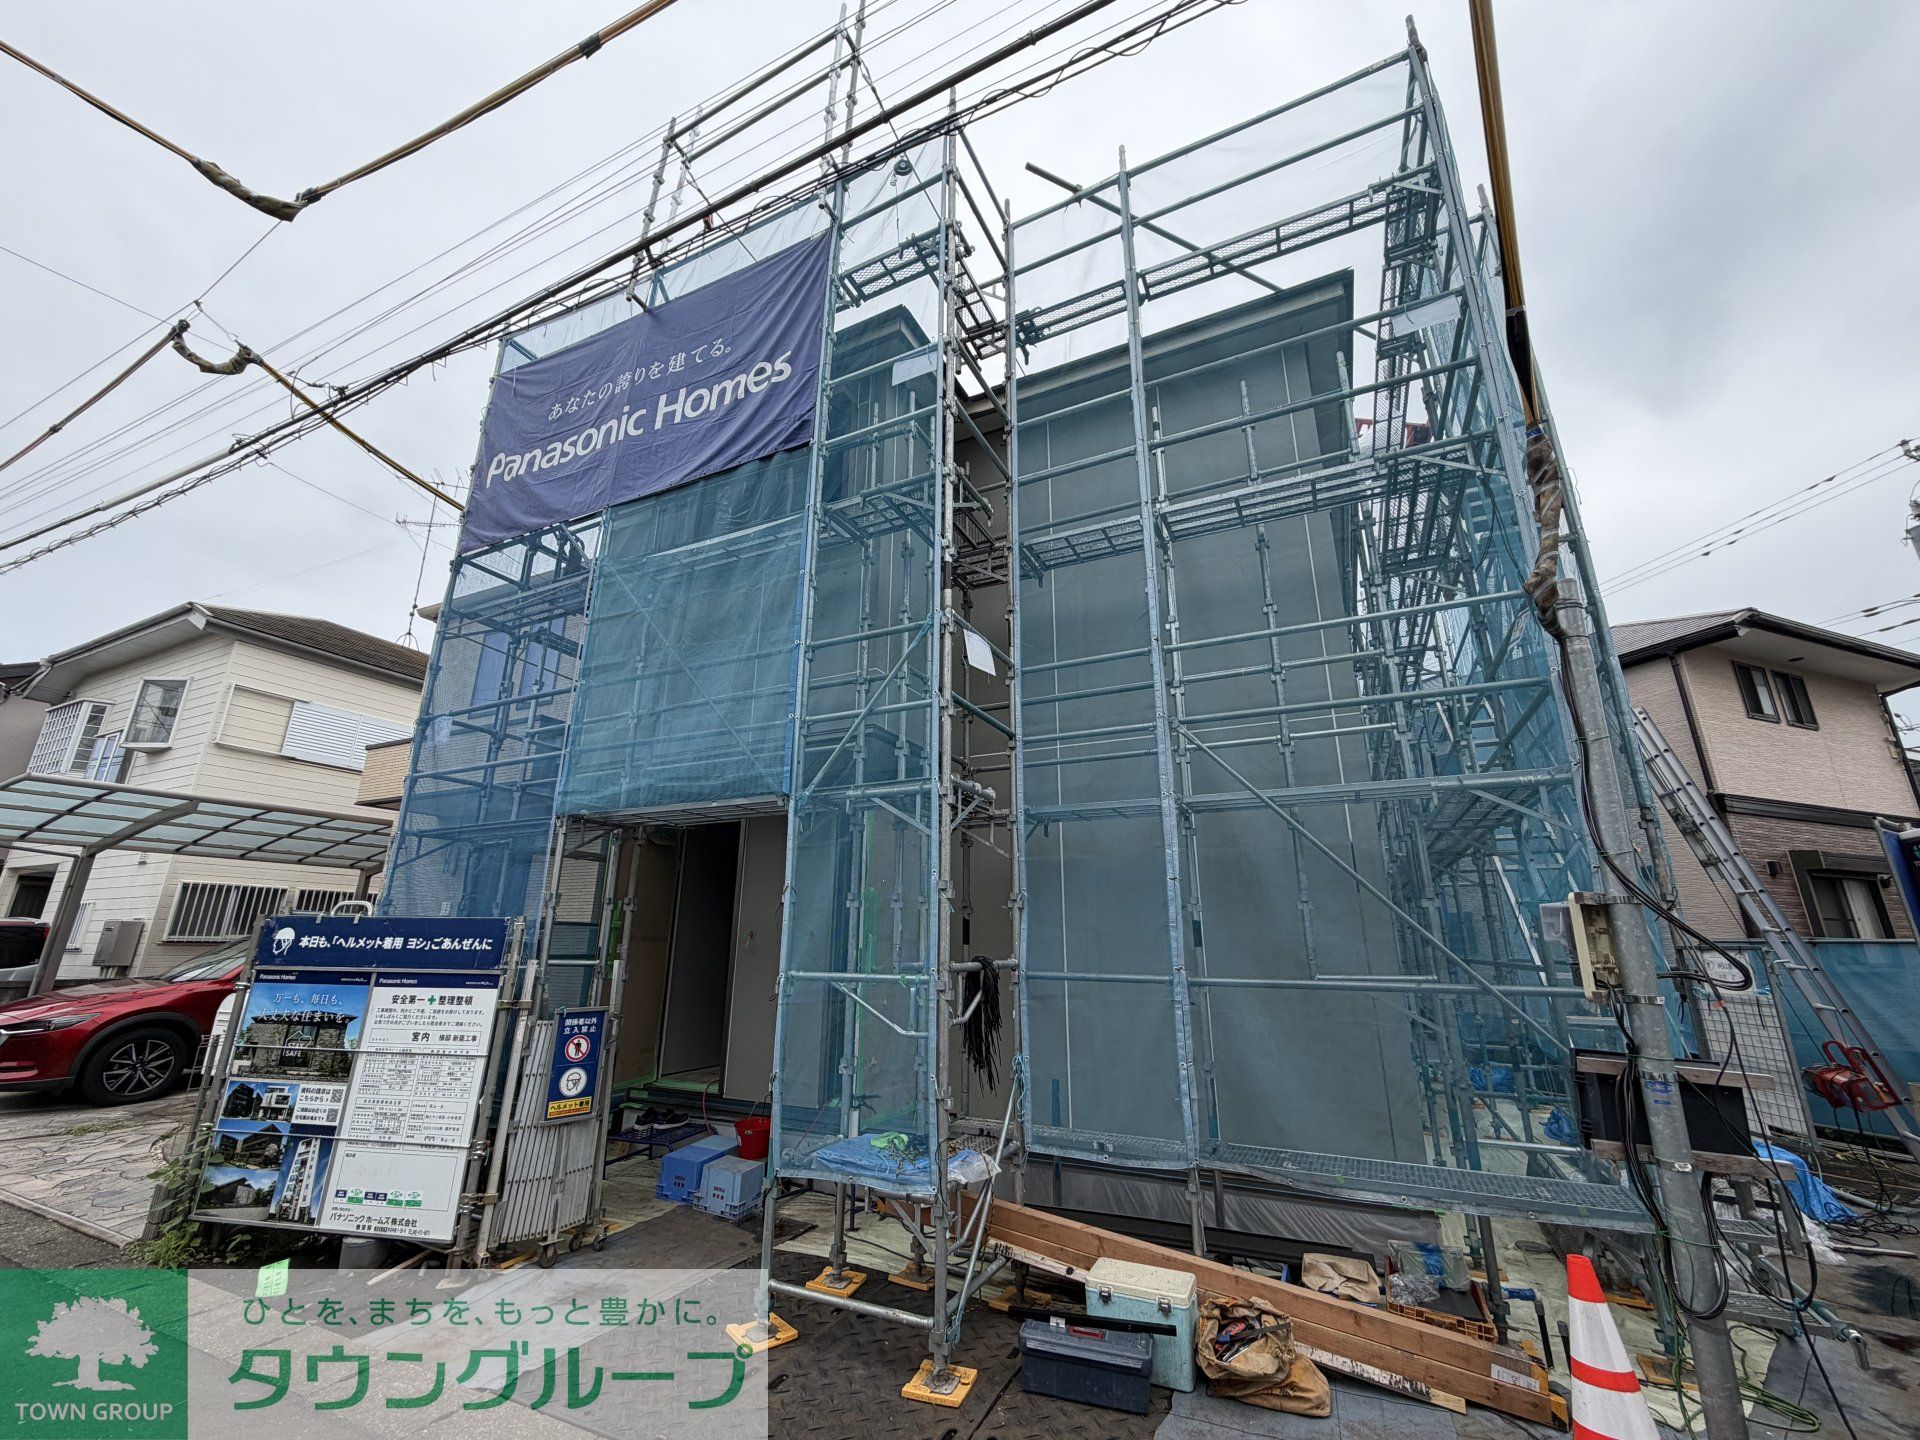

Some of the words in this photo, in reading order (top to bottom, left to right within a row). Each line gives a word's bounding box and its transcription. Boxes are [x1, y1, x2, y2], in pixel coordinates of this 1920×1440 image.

[547, 337, 732, 422] あなたの誇りを建てる。
[485, 404, 648, 489] Panasonic
[653, 350, 794, 430] Homes
[298, 935, 404, 950] 本日も、「ヘルメット着用
[406, 937, 493, 950] ヨシ」ごあんぜんに
[391, 995, 425, 1005] 安全第一
[438, 995, 474, 1006] 整理整頓
[257, 1008, 350, 1024] 大丈夫な住まいを。
[564, 1017, 598, 1026] 関係者以外
[563, 1026, 597, 1035] 立入禁止
[411, 1032, 430, 1042] 宮内
[285, 1049, 302, 1057] SAFE
